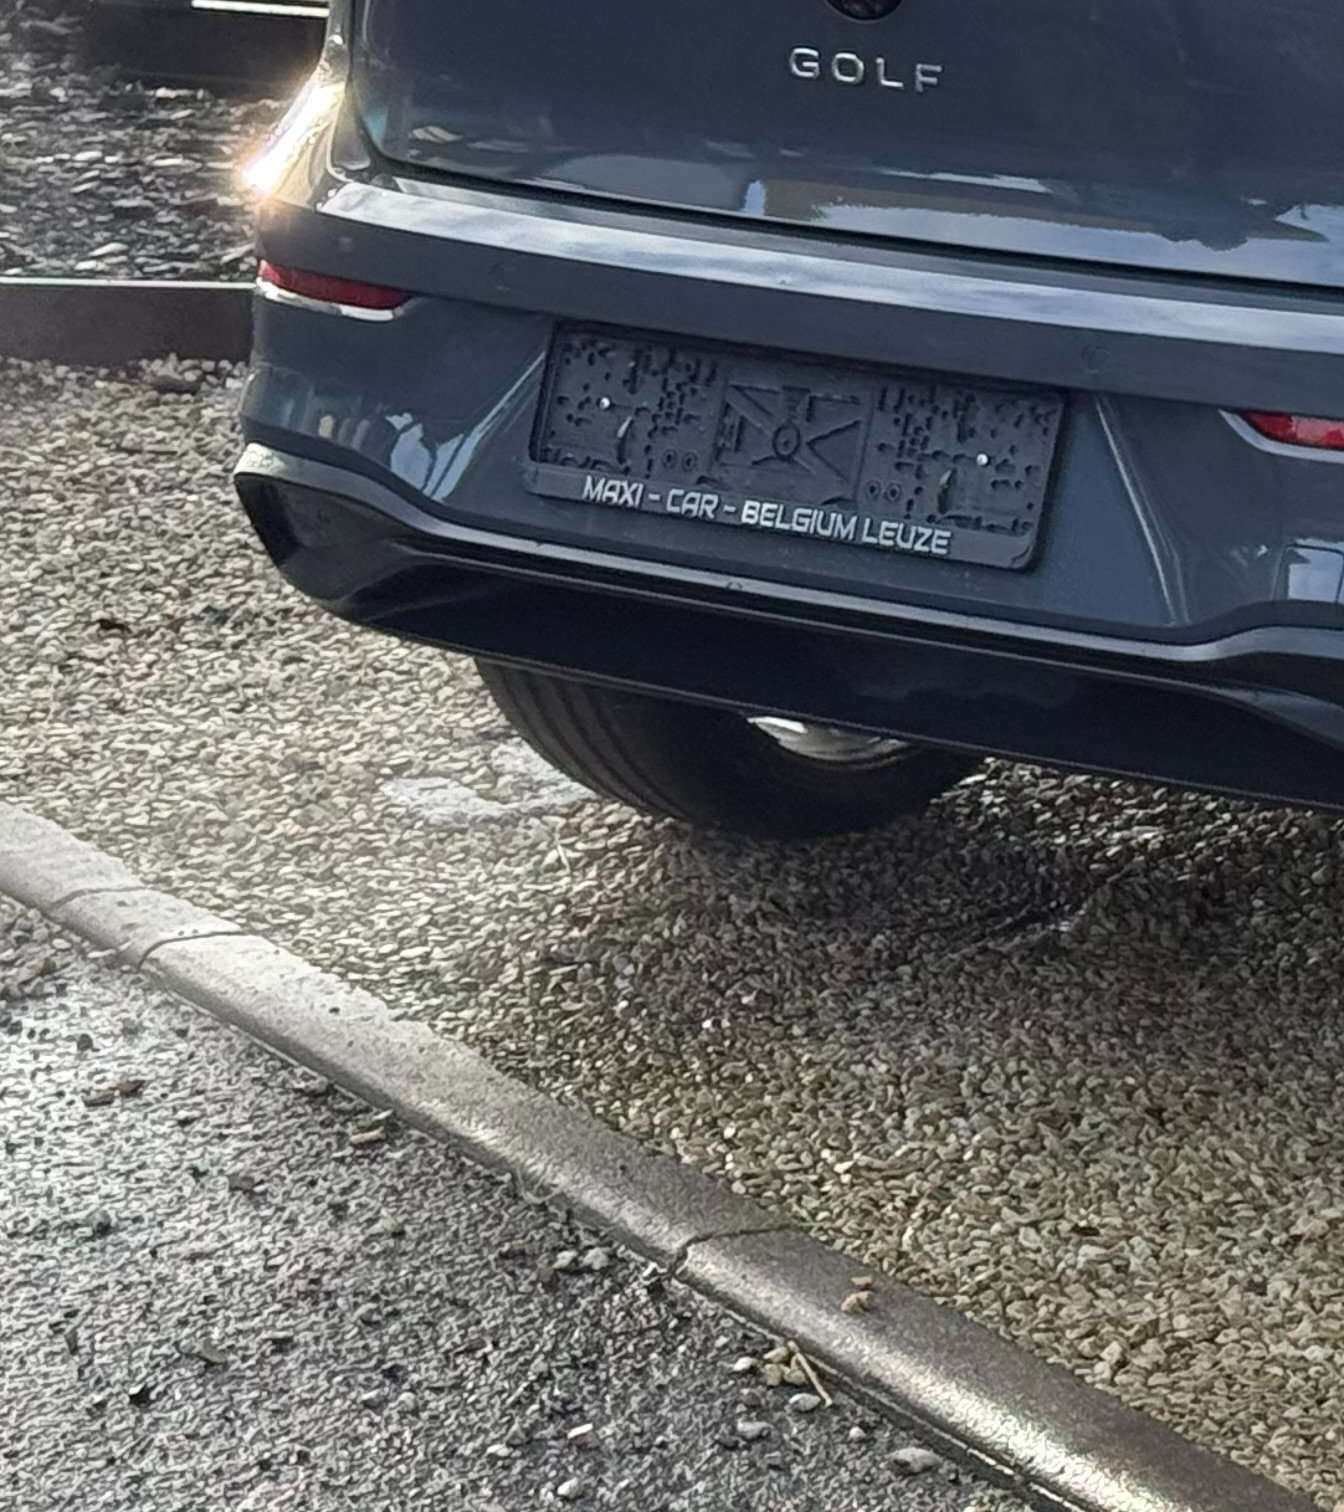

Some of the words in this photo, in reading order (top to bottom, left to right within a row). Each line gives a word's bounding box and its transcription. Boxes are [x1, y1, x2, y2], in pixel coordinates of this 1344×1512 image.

[789, 47, 943, 93] GOLF
[582, 475, 644, 508] MAXI
[666, 488, 719, 519] CAR
[740, 499, 858, 541] BELGIUM
[861, 517, 951, 555] LEUZE
